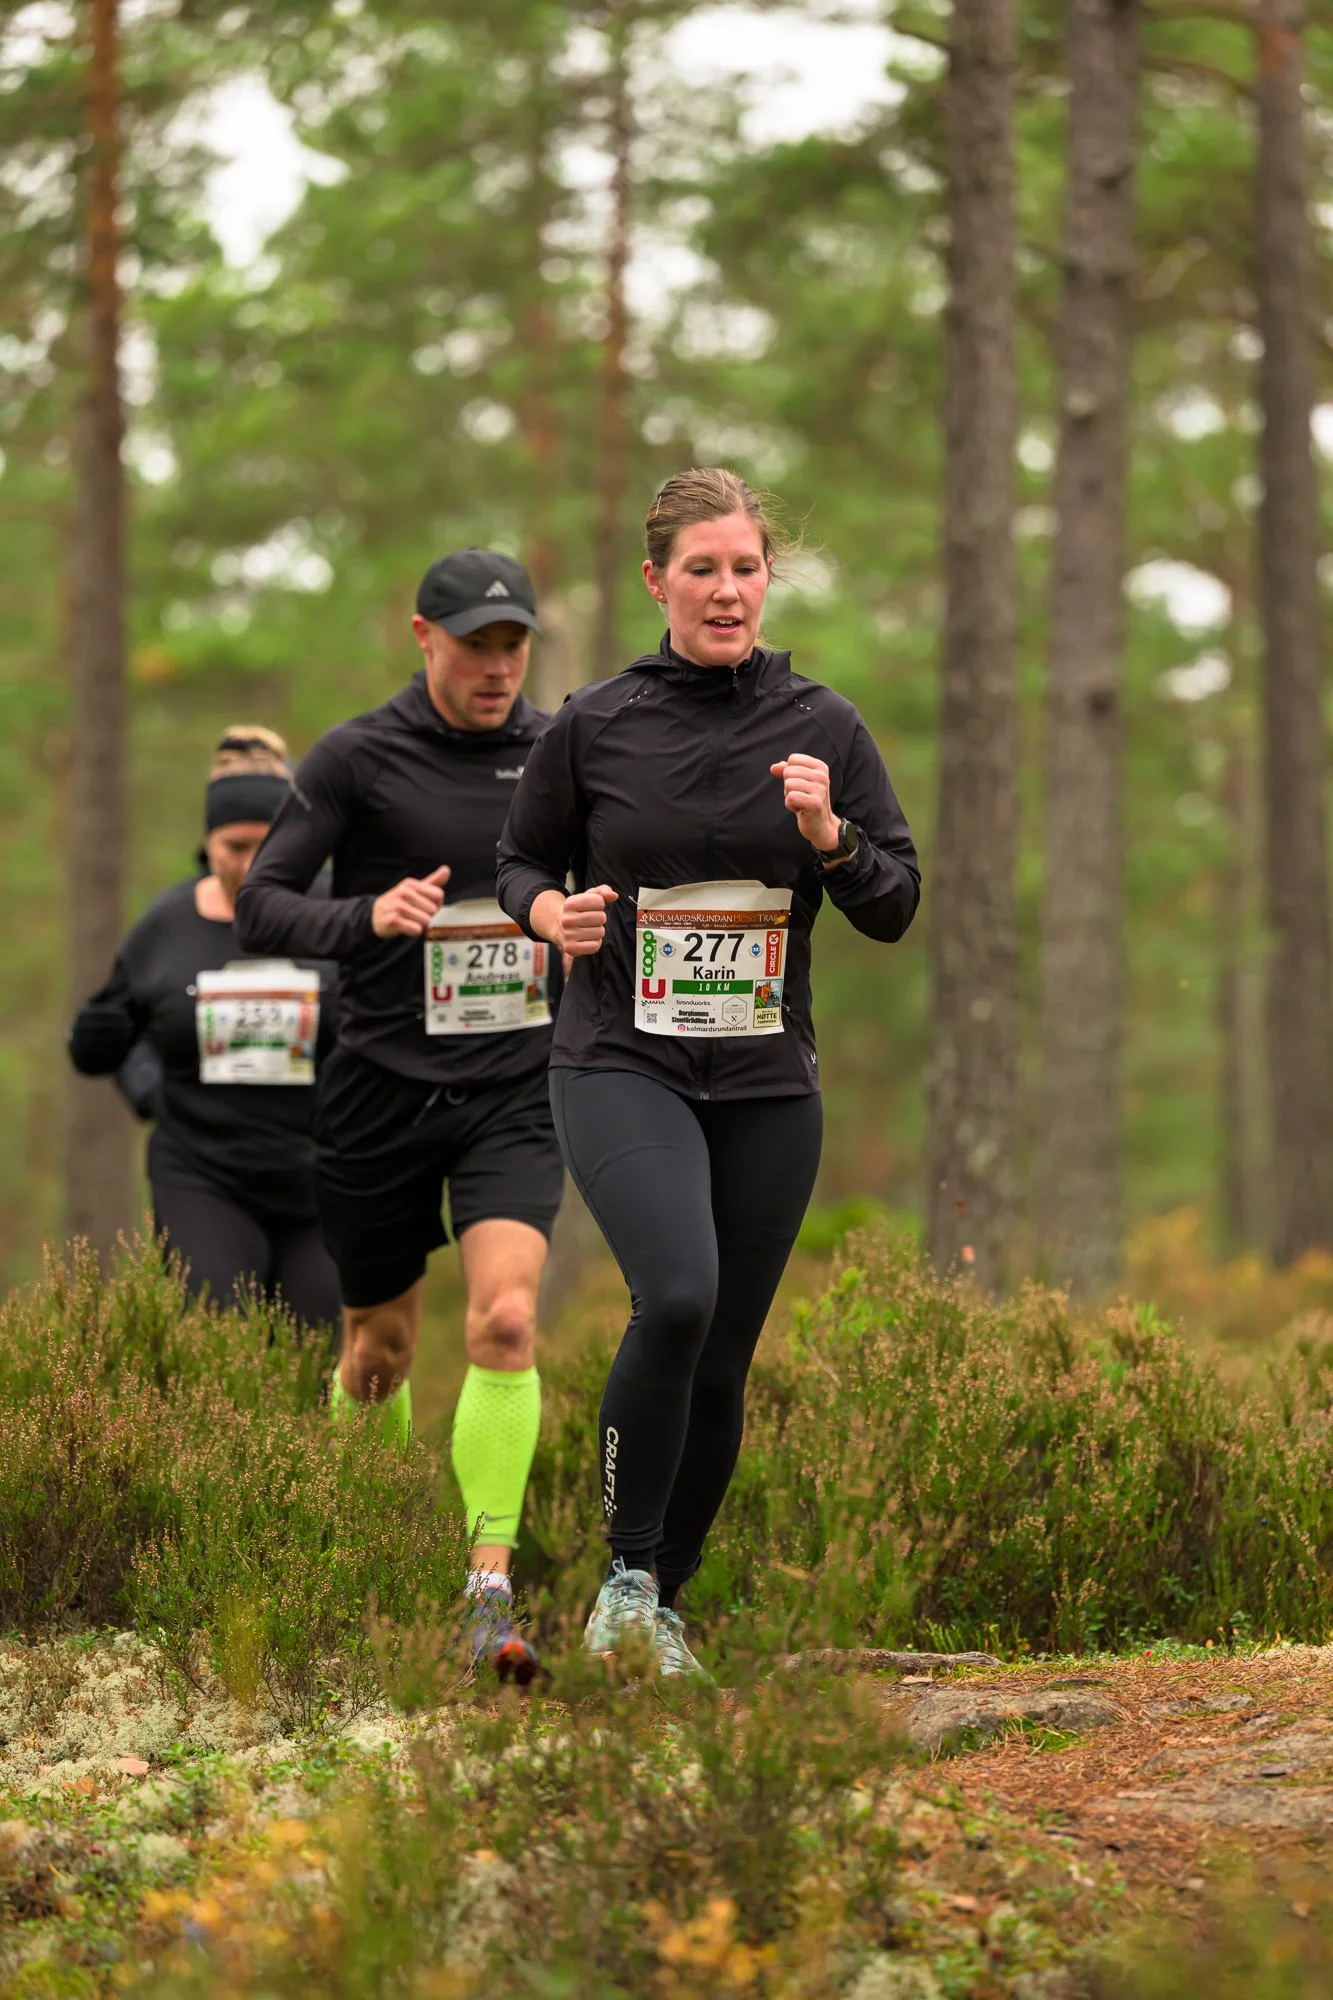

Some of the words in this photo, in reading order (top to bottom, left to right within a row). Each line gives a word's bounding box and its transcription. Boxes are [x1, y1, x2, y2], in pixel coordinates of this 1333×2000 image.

[467, 942, 517, 970] 278
[643, 930, 657, 977] coop
[683, 933, 745, 962] 277
[769, 946, 777, 973] CIRCLE
[466, 972, 520, 983] Andreas
[694, 966, 735, 980] Karin
[699, 983, 711, 992] 10
[717, 983, 730, 992] KM
[756, 1013, 778, 1021] NØTTE
[605, 1426, 619, 1500] CRAFT
